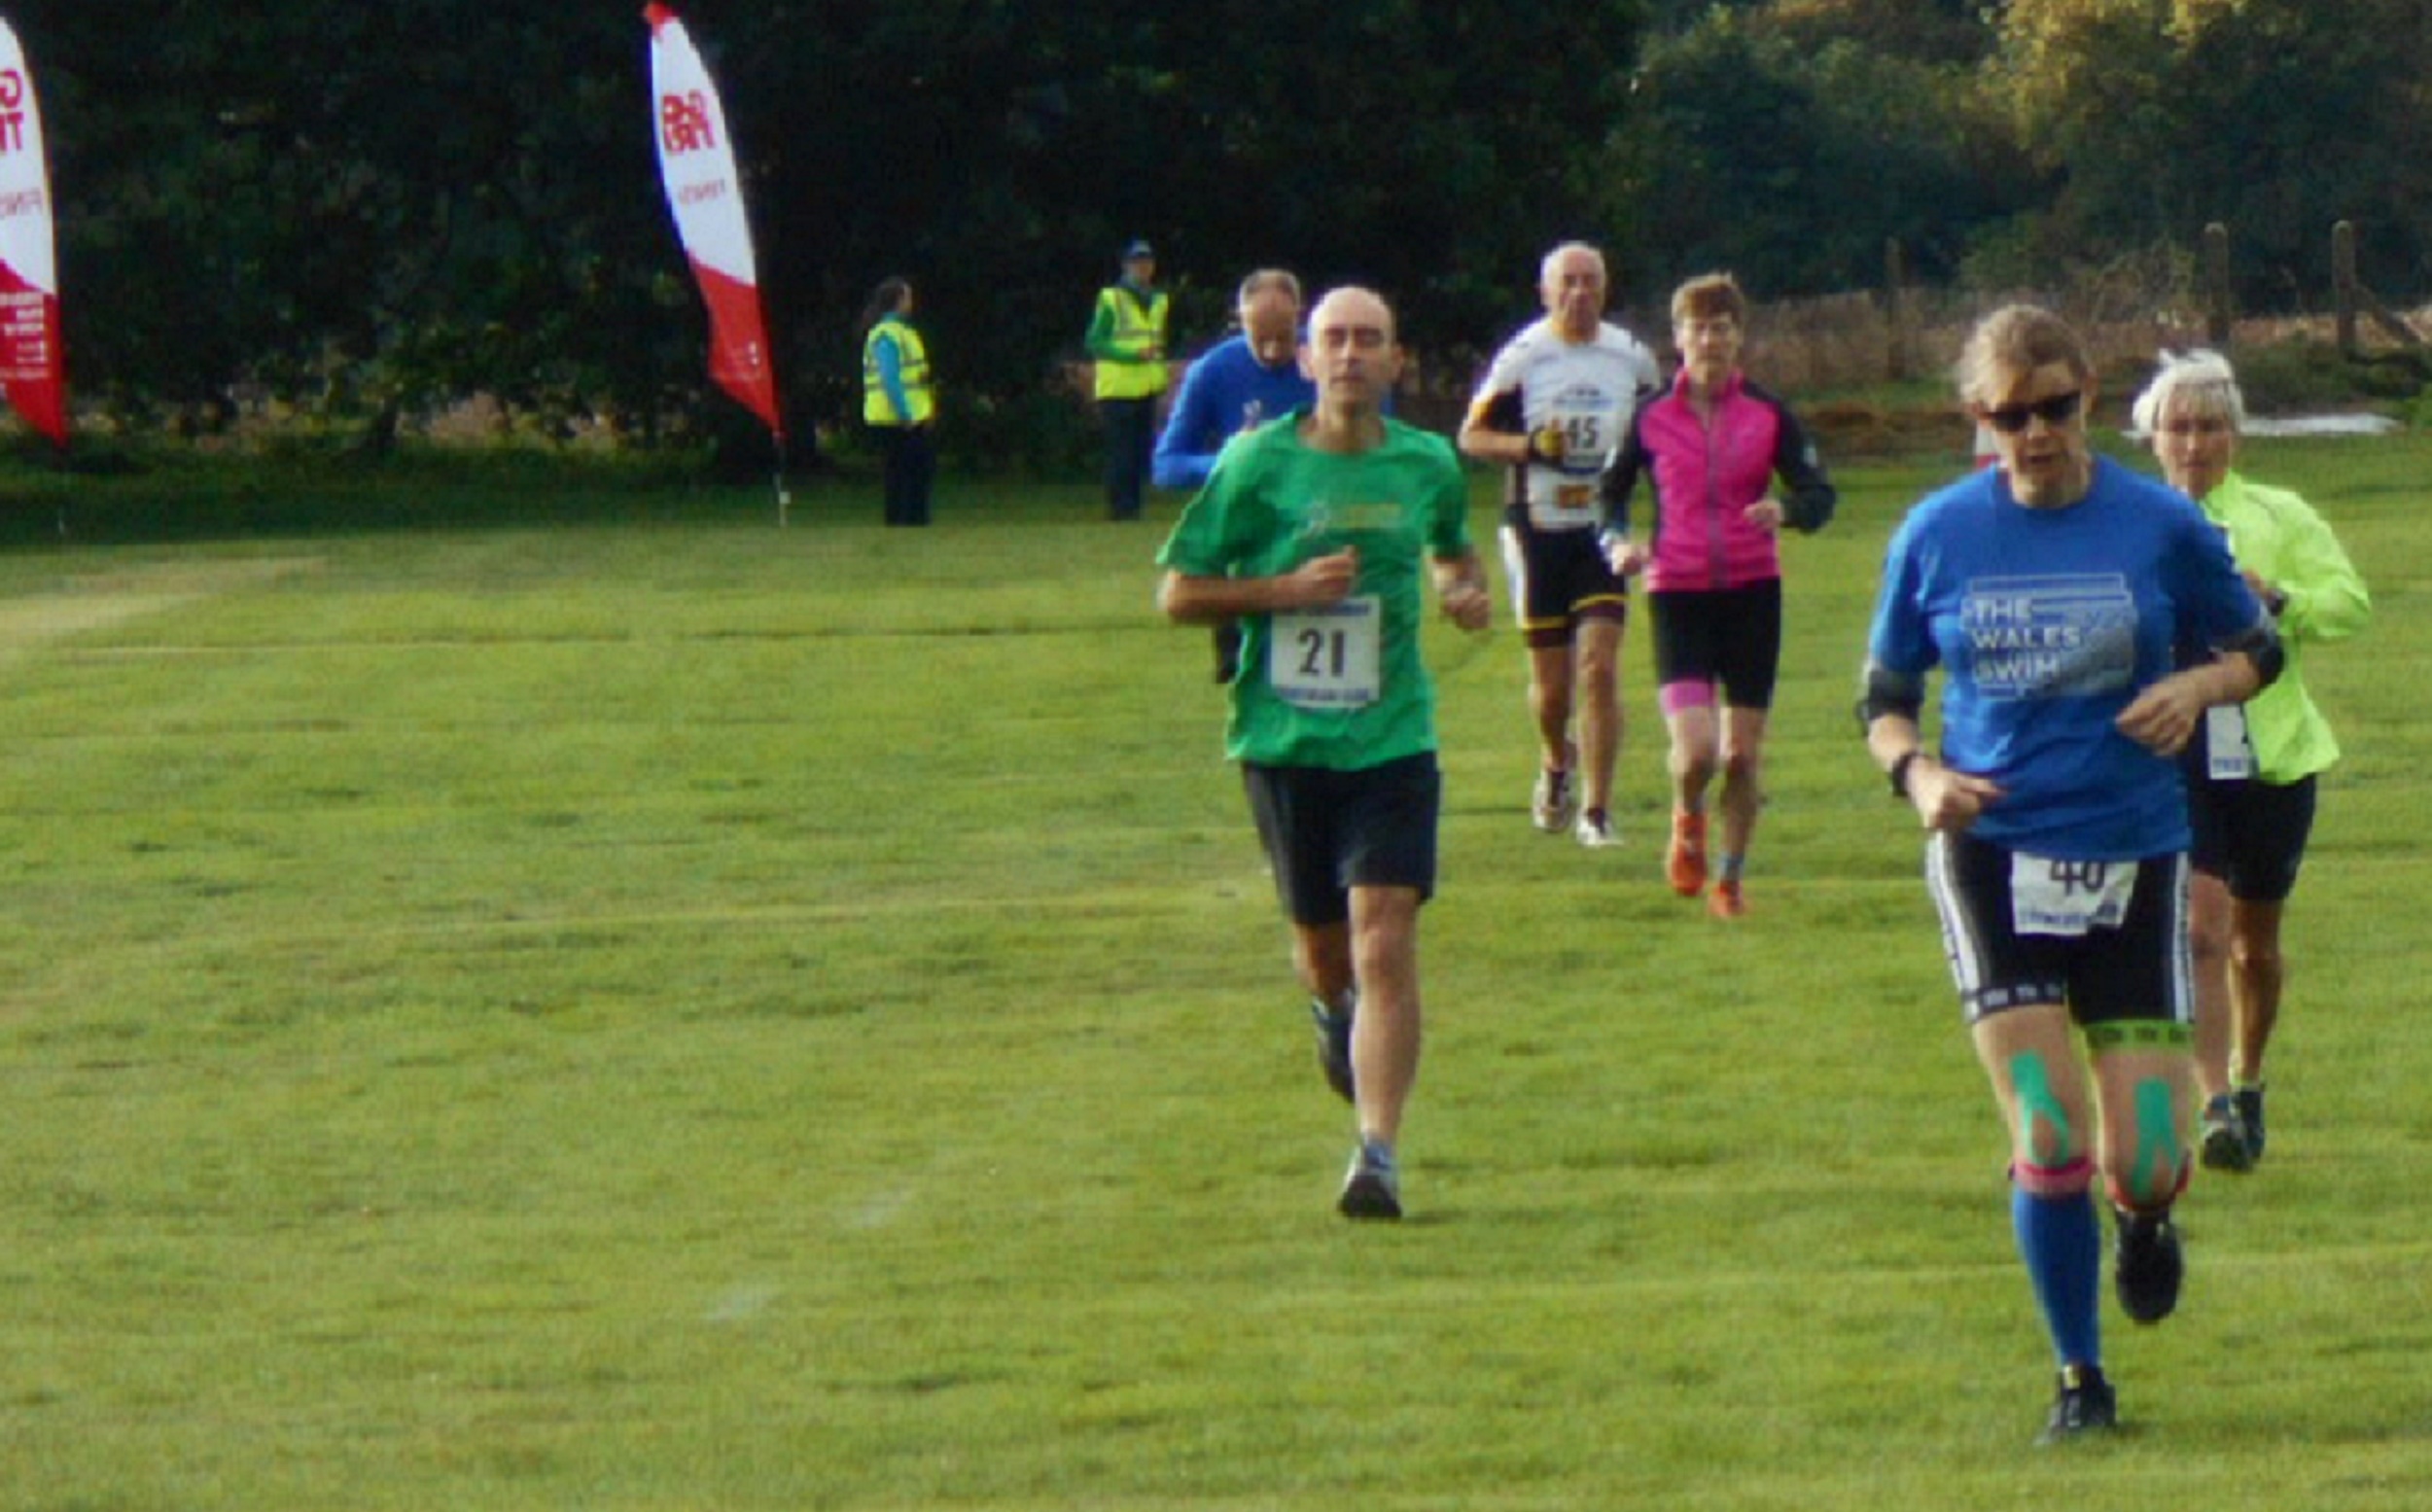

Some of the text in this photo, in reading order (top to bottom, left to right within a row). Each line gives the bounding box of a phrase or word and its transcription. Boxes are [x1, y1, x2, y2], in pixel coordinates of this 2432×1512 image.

[1974, 598, 2032, 625] THE
[1297, 628, 1346, 678] 21
[1971, 626, 2081, 650] WALES
[1973, 651, 2061, 685] SWIM
[2049, 860, 2106, 897] 40
